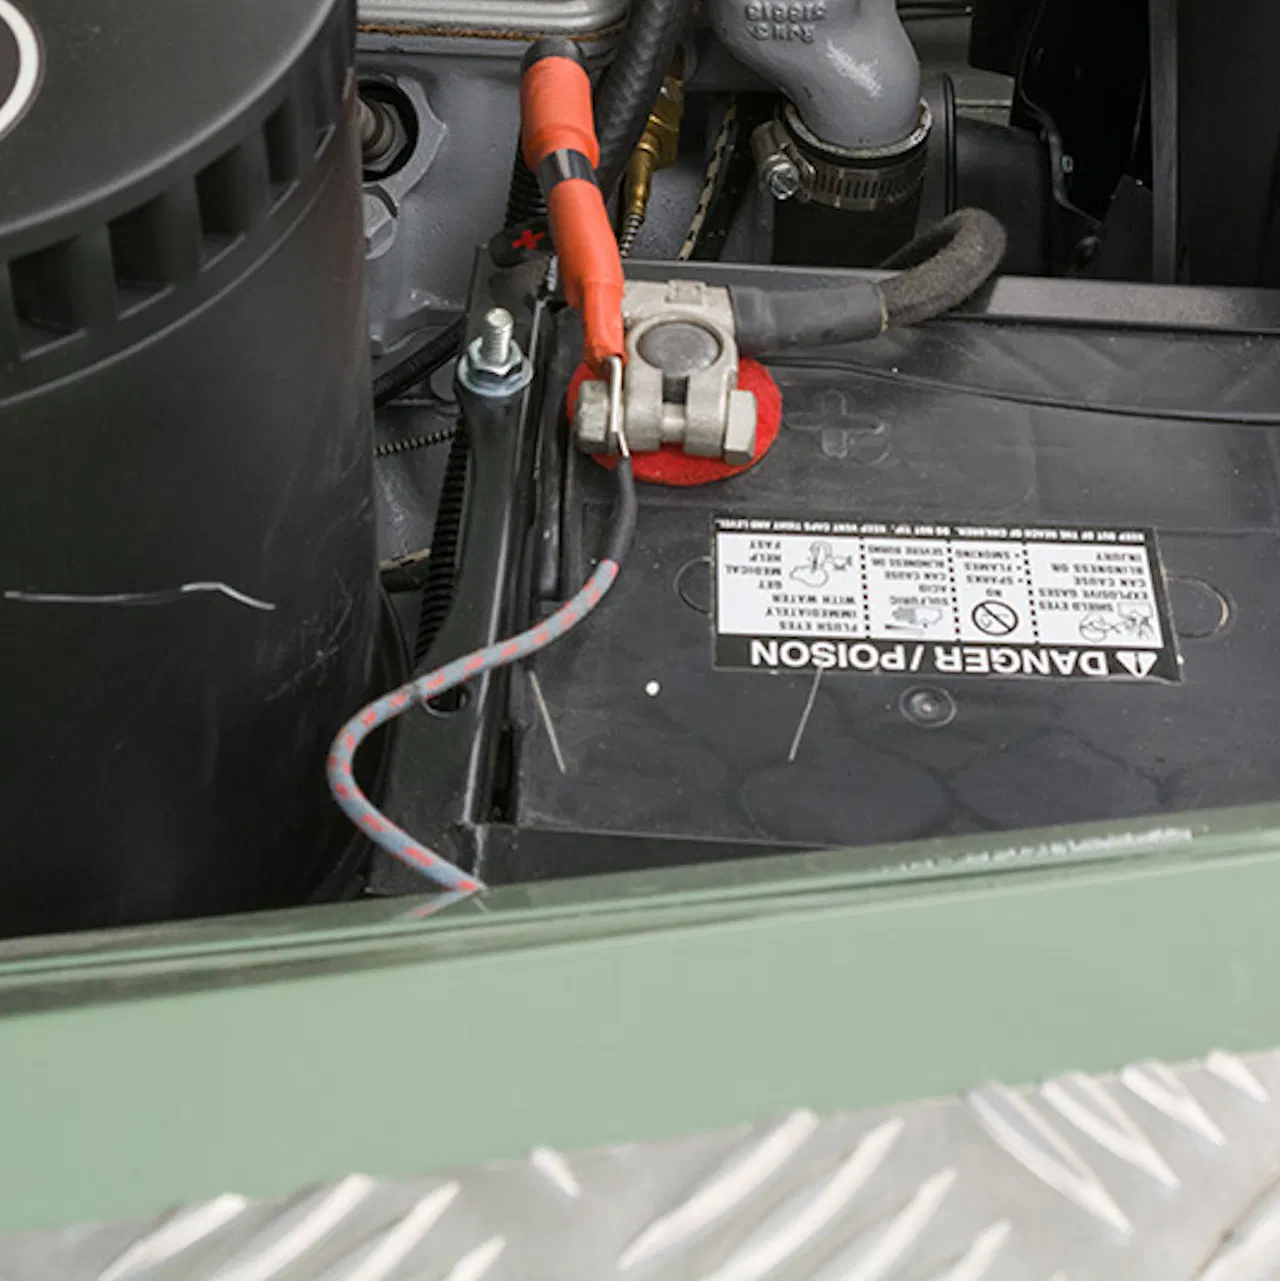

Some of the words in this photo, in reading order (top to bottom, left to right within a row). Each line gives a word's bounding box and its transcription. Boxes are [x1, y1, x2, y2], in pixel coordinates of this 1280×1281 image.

[749, 540, 782, 550] FAST
[905, 546, 944, 556] SEVERE
[955, 549, 1011, 560] SMOKING
[749, 553, 782, 563] HELP
[1096, 552, 1142, 562] INJURY
[889, 558, 946, 569] BLINDNESS
[964, 562, 1013, 573] FLAMES
[725, 565, 783, 576] MEDICAL
[1072, 564, 1144, 575] BLINDNESS
[884, 571, 920, 580] CAUSE
[922, 572, 947, 581] CAN
[966, 575, 1014, 585] SPARKS
[759, 579, 783, 590] GET
[1073, 577, 1115, 587] CAUSE
[1119, 578, 1146, 588] CAN
[918, 584, 948, 593] ACID
[985, 588, 1003, 598] NO
[1038, 587, 1078, 598] GASES
[1083, 588, 1148, 600] EXPLOSIVE
[772, 593, 819, 604] WATER
[822, 594, 855, 604] WITH
[889, 595, 950, 606] SULFURIC
[1038, 600, 1069, 611] EYES
[1072, 601, 1114, 612] SHIELD
[765, 608, 857, 619] IMMEDIATELY
[779, 621, 813, 631] EYES
[819, 621, 858, 632] FLUSH
[750, 638, 907, 670] POISON
[933, 645, 1110, 676] DANGER
